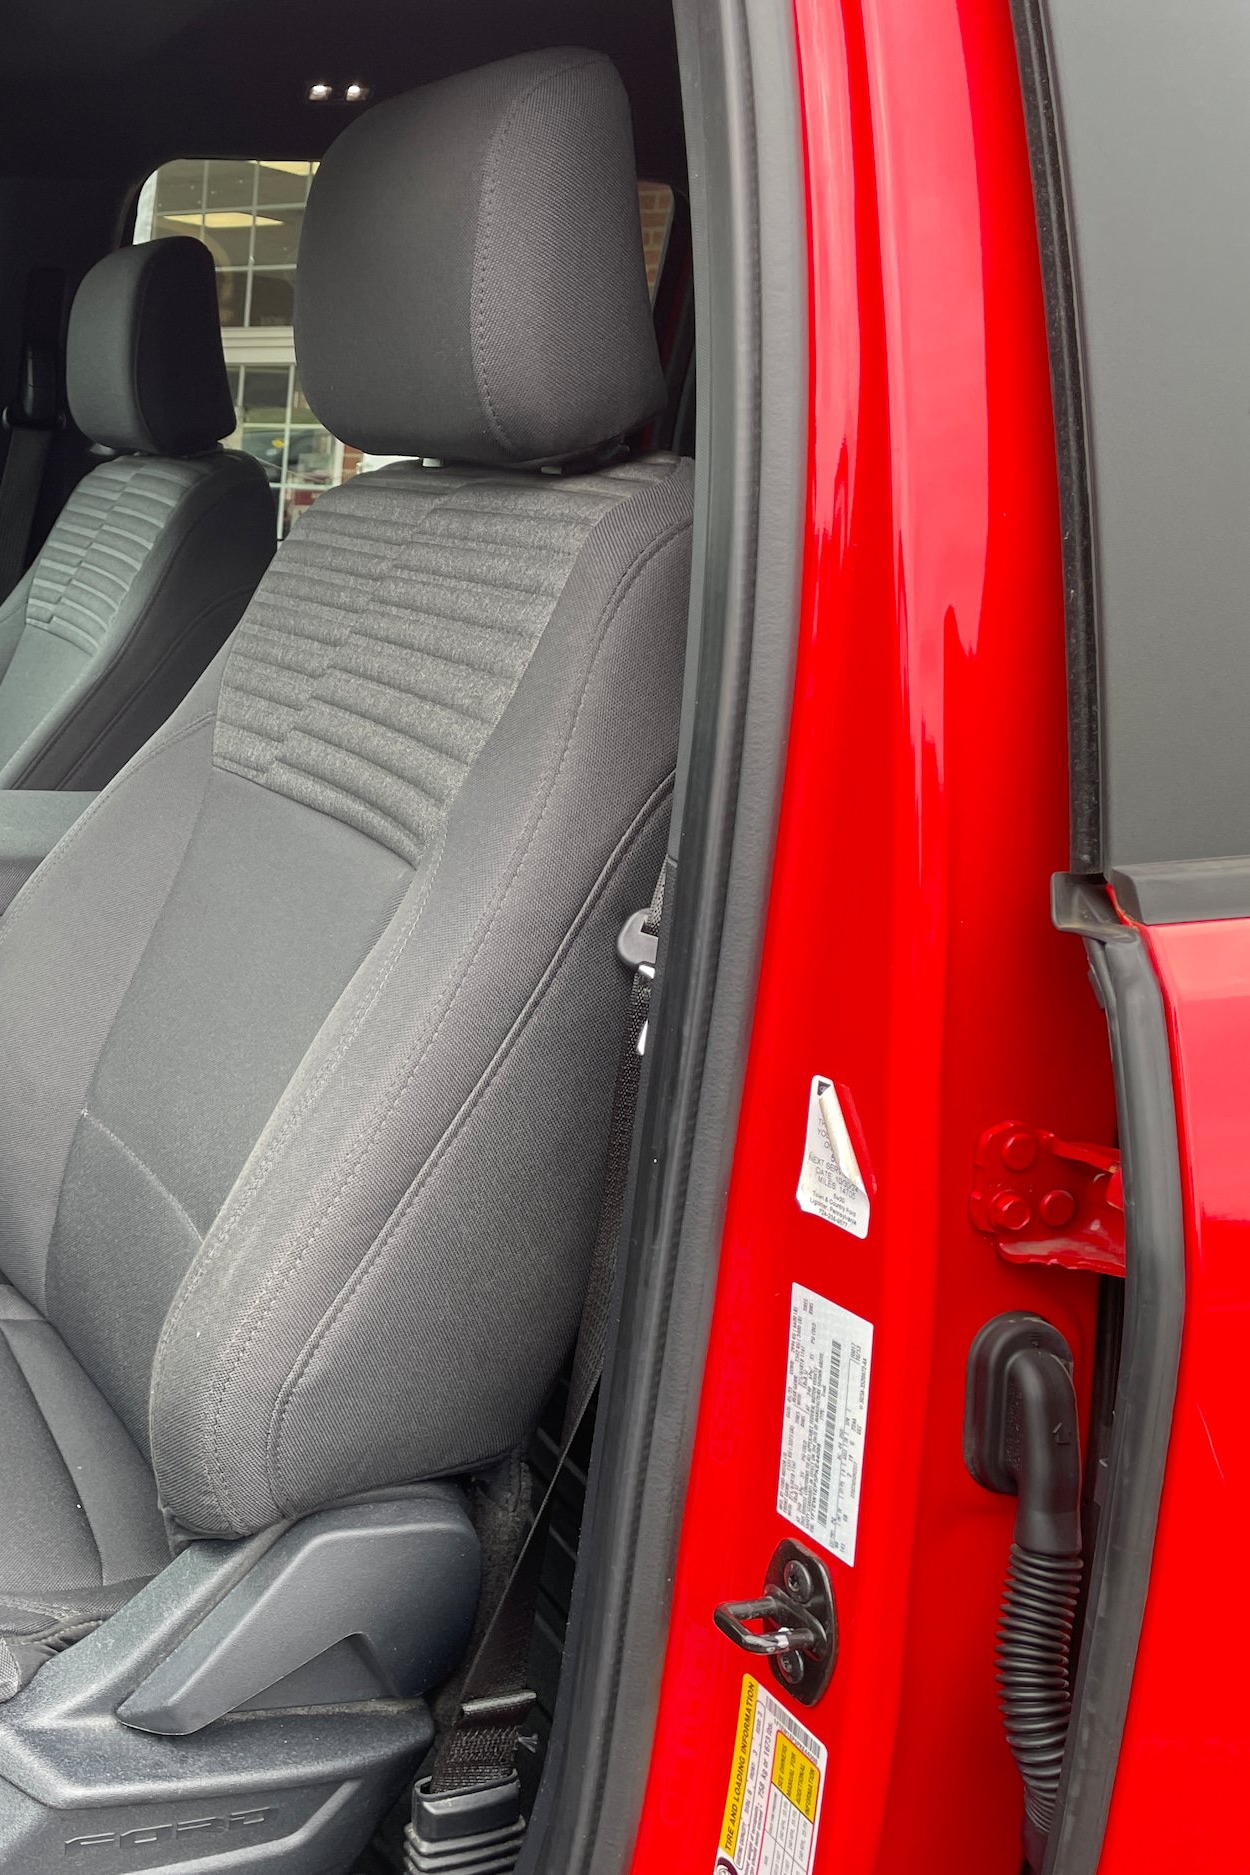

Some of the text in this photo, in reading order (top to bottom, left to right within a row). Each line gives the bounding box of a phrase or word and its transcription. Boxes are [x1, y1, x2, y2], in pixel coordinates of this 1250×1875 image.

[725, 1681, 755, 1850] TIRE AND LOADING INFORMATION
[762, 1758, 769, 1769] or
[763, 1736, 772, 1757] 1673
[757, 1780, 765, 1799] 758
[760, 1767, 768, 1781] kg
[786, 1751, 797, 1797] MANUAL FOR
[795, 1765, 805, 1805] ADDITIONAL
[804, 1767, 815, 1815] INFORMATION
[64, 1805, 280, 1857] FORD
